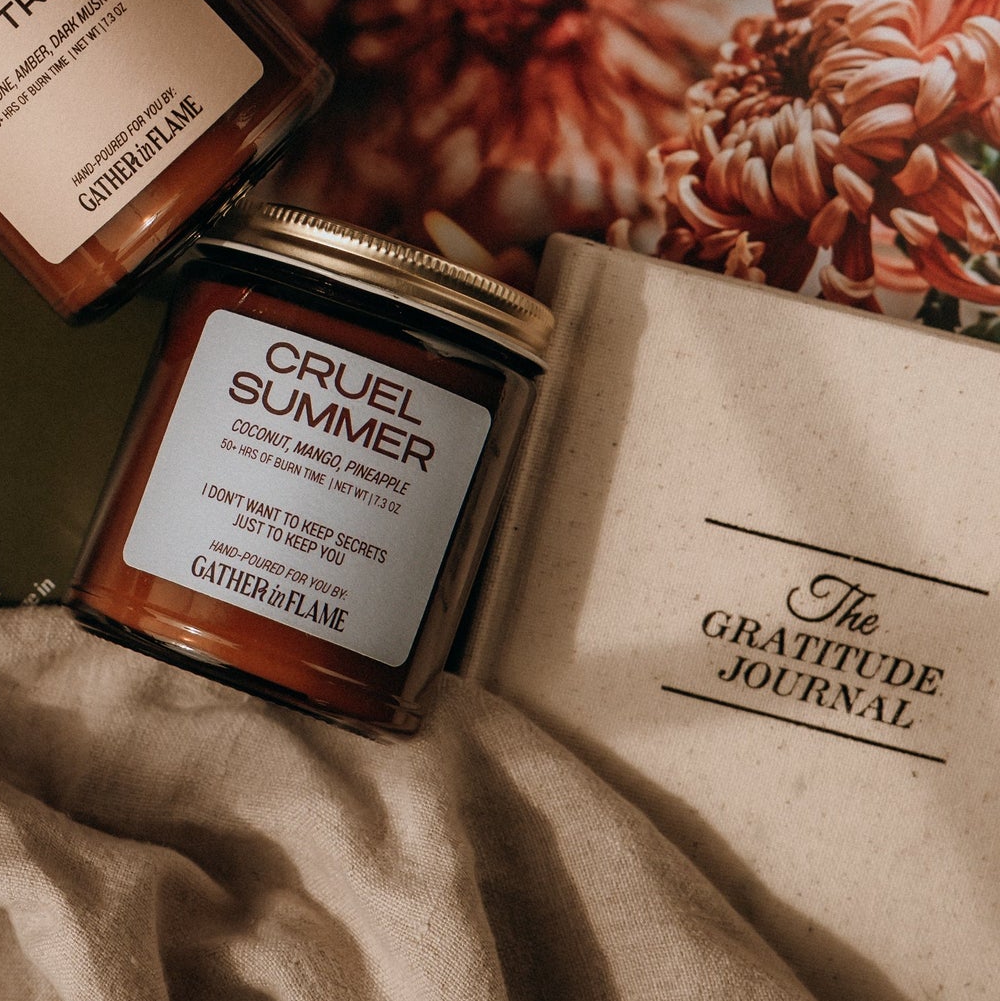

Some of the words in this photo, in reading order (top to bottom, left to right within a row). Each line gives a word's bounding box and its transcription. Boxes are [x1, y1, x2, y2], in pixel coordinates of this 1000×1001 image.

[1, 101, 21, 120] HRS
[17, 91, 29, 106] OF
[26, 71, 52, 97] BURN
[47, 55, 70, 76] TIME
[71, 36, 89, 55] NET
[85, 25, 101, 41] WT
[100, 12, 117, 27] 7.3
[112, 1, 128, 17] OZ
[14, 44, 54, 83] AMBER,
[48, 15, 80, 49] DARK
[71, 130, 129, 187] HAND-POURED
[126, 114, 147, 137] FOR
[143, 97, 163, 120] YOU
[160, 86, 177, 105] BY:
[134, 142, 157, 163] in
[145, 94, 204, 151] FLAME
[78, 151, 144, 212] GATHER
[228, 371, 436, 473] SUMMER
[265, 341, 422, 426] CRUEL
[220, 437, 237, 451] 50+
[238, 444, 259, 460] HRS
[259, 451, 274, 464] OF
[273, 456, 303, 476] BURN
[303, 467, 327, 486] TIME
[333, 479, 354, 495] NET
[354, 486, 370, 501] WT
[373, 494, 388, 509] 7.3
[387, 500, 402, 515] OZ
[231, 418, 293, 454] COCONUT,
[292, 440, 342, 473] MANGO,
[344, 460, 411, 496] PINEAPPLE
[201, 482, 208, 496] I
[207, 484, 246, 508] DON'T
[245, 497, 282, 522] WANT
[283, 511, 300, 529] TO
[300, 519, 335, 541] KEEP
[334, 532, 388, 564] SECRETS
[232, 513, 266, 535] JUST
[266, 524, 284, 542] TO
[284, 531, 318, 554] KEEP
[320, 544, 346, 566] YOU
[191, 555, 270, 602] GATHER
[266, 584, 286, 609] in
[283, 589, 349, 633] FLAME
[208, 539, 286, 576] HAND-POURED
[284, 568, 309, 586] FOR
[309, 576, 333, 594] YOU
[329, 585, 348, 601] BY:
[786, 573, 879, 636] The
[701, 610, 945, 696] GRATITUDE
[717, 655, 914, 729] JOURNAL
